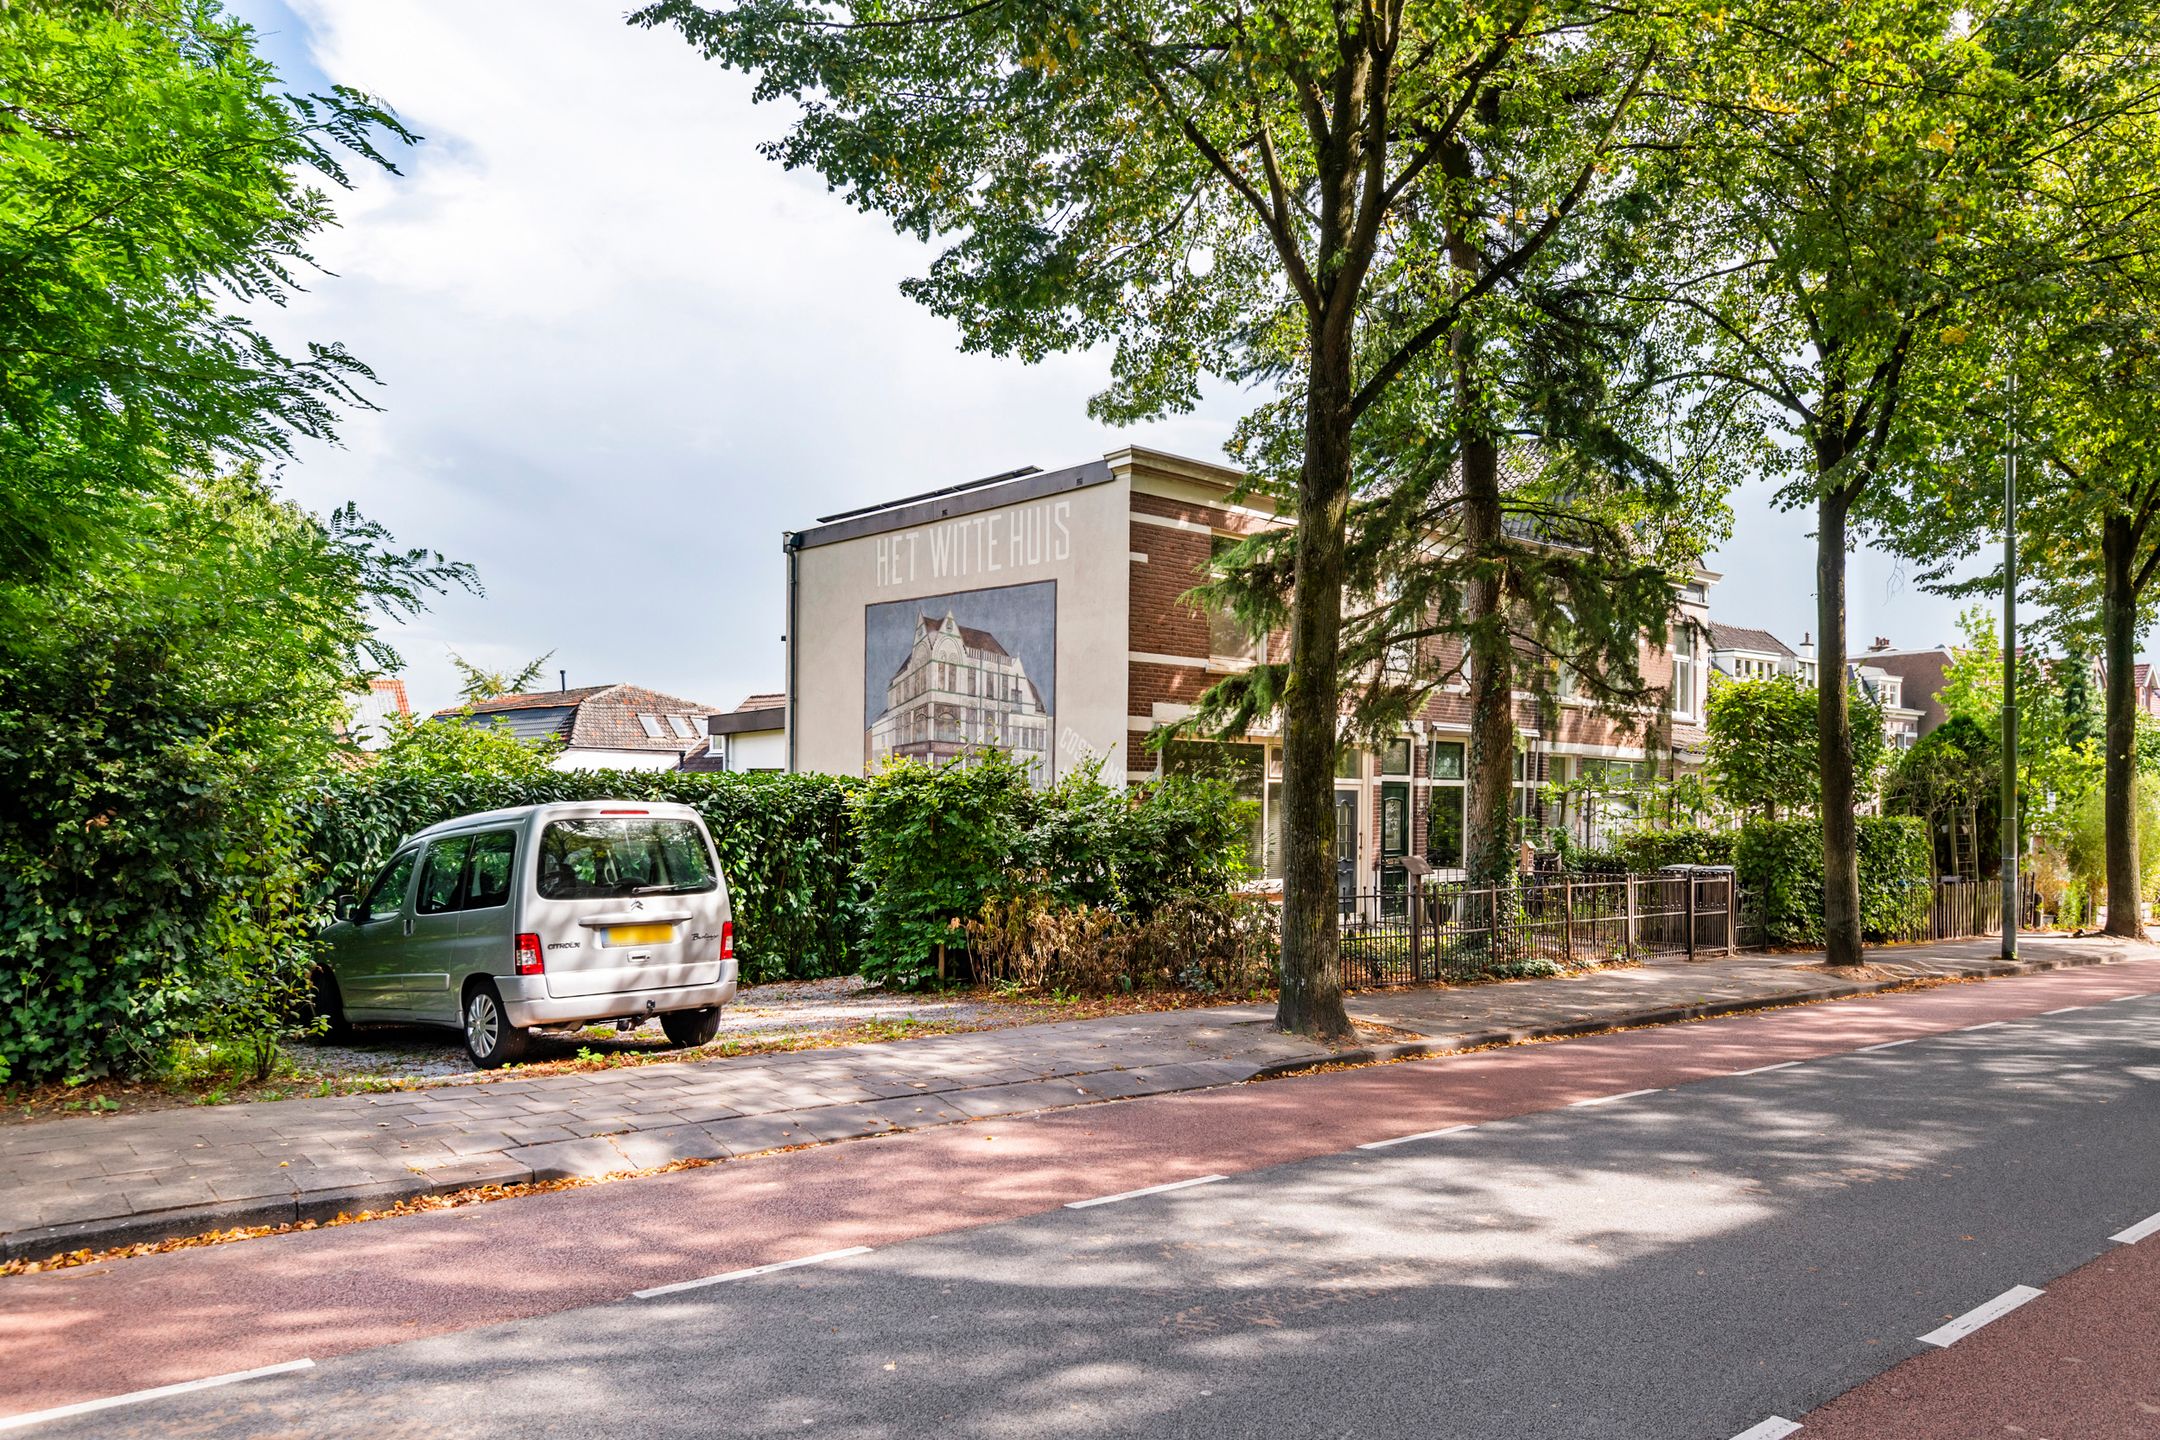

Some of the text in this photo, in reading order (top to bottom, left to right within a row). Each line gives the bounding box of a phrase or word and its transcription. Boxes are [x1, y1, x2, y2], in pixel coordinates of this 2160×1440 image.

[876, 501, 1070, 587] HET WITTE HUIS
